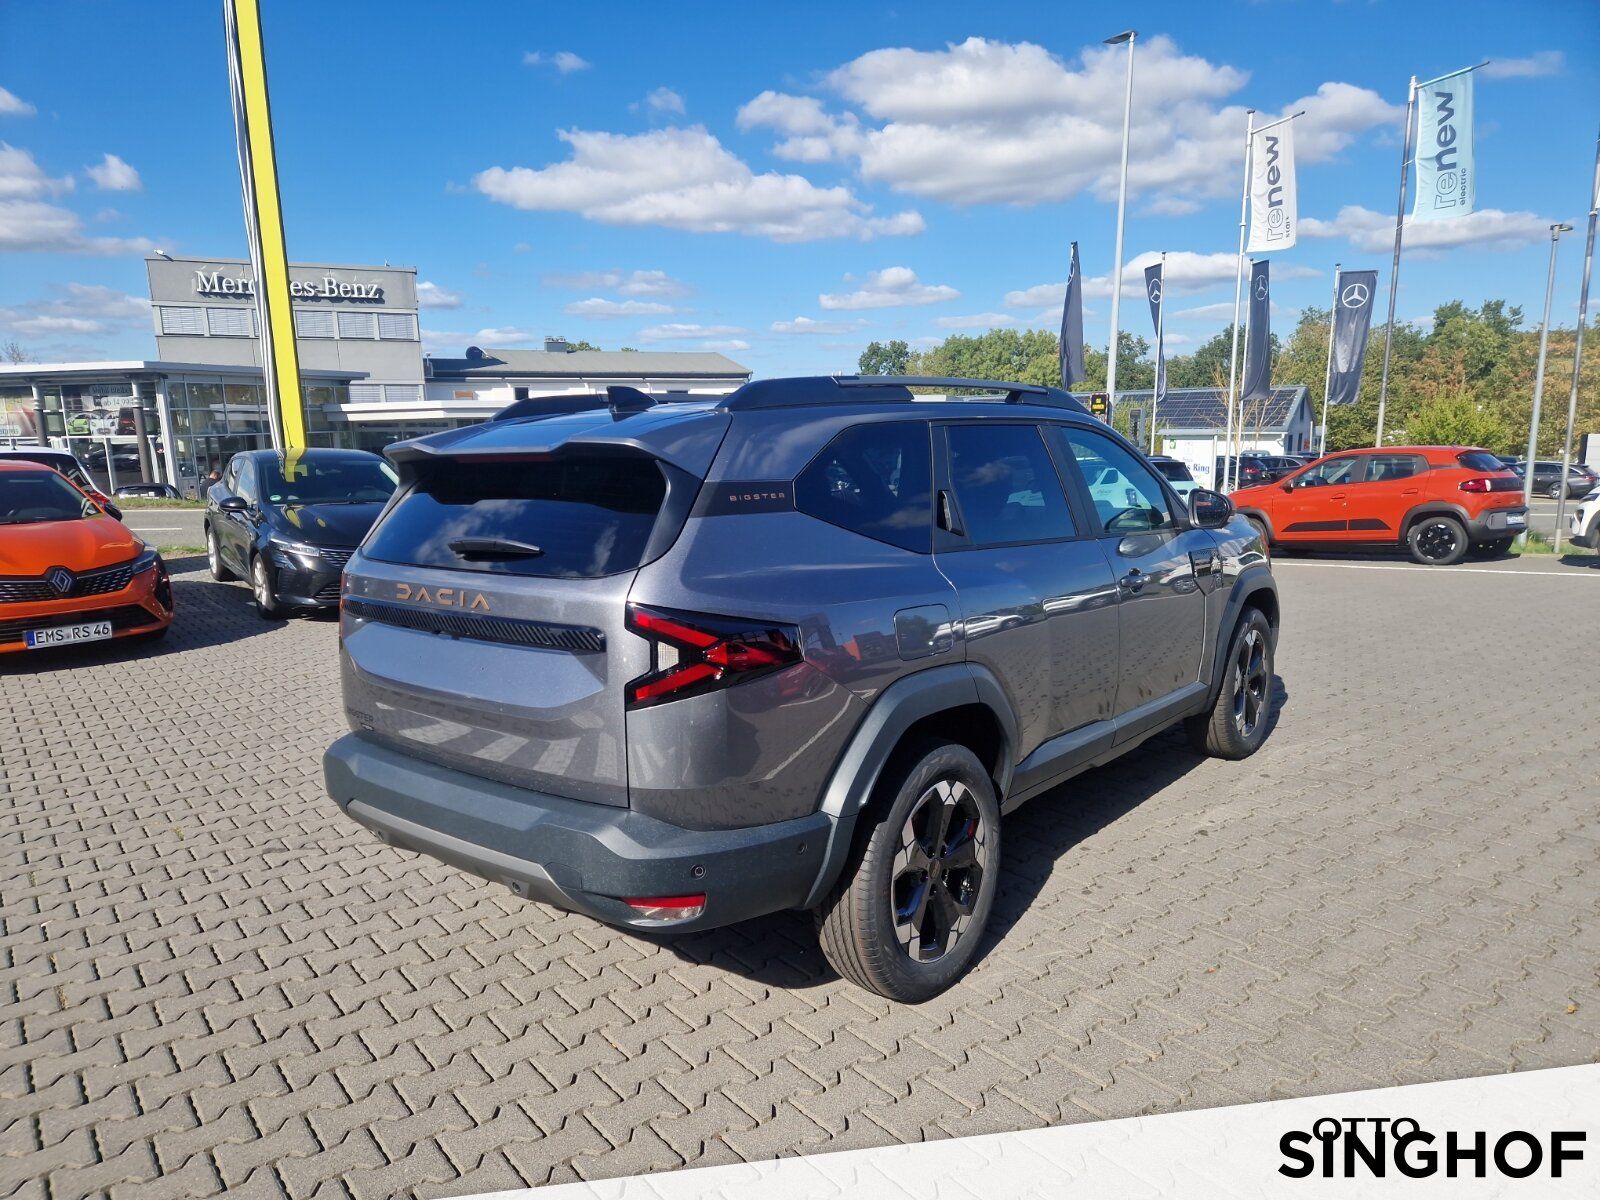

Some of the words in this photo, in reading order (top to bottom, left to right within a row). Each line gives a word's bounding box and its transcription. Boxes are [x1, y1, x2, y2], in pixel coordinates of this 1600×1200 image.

[1434, 91, 1458, 210] renew
[1265, 135, 1284, 242] renew
[1459, 167, 1467, 206] electric
[195, 270, 380, 299] Merces-Benz
[1193, 463, 1210, 475] Ring
[729, 492, 785, 502] BIGSTER
[396, 583, 491, 611] DACIA
[35, 629, 64, 644] EMS
[72, 625, 90, 640] RS
[93, 623, 110, 636] 46
